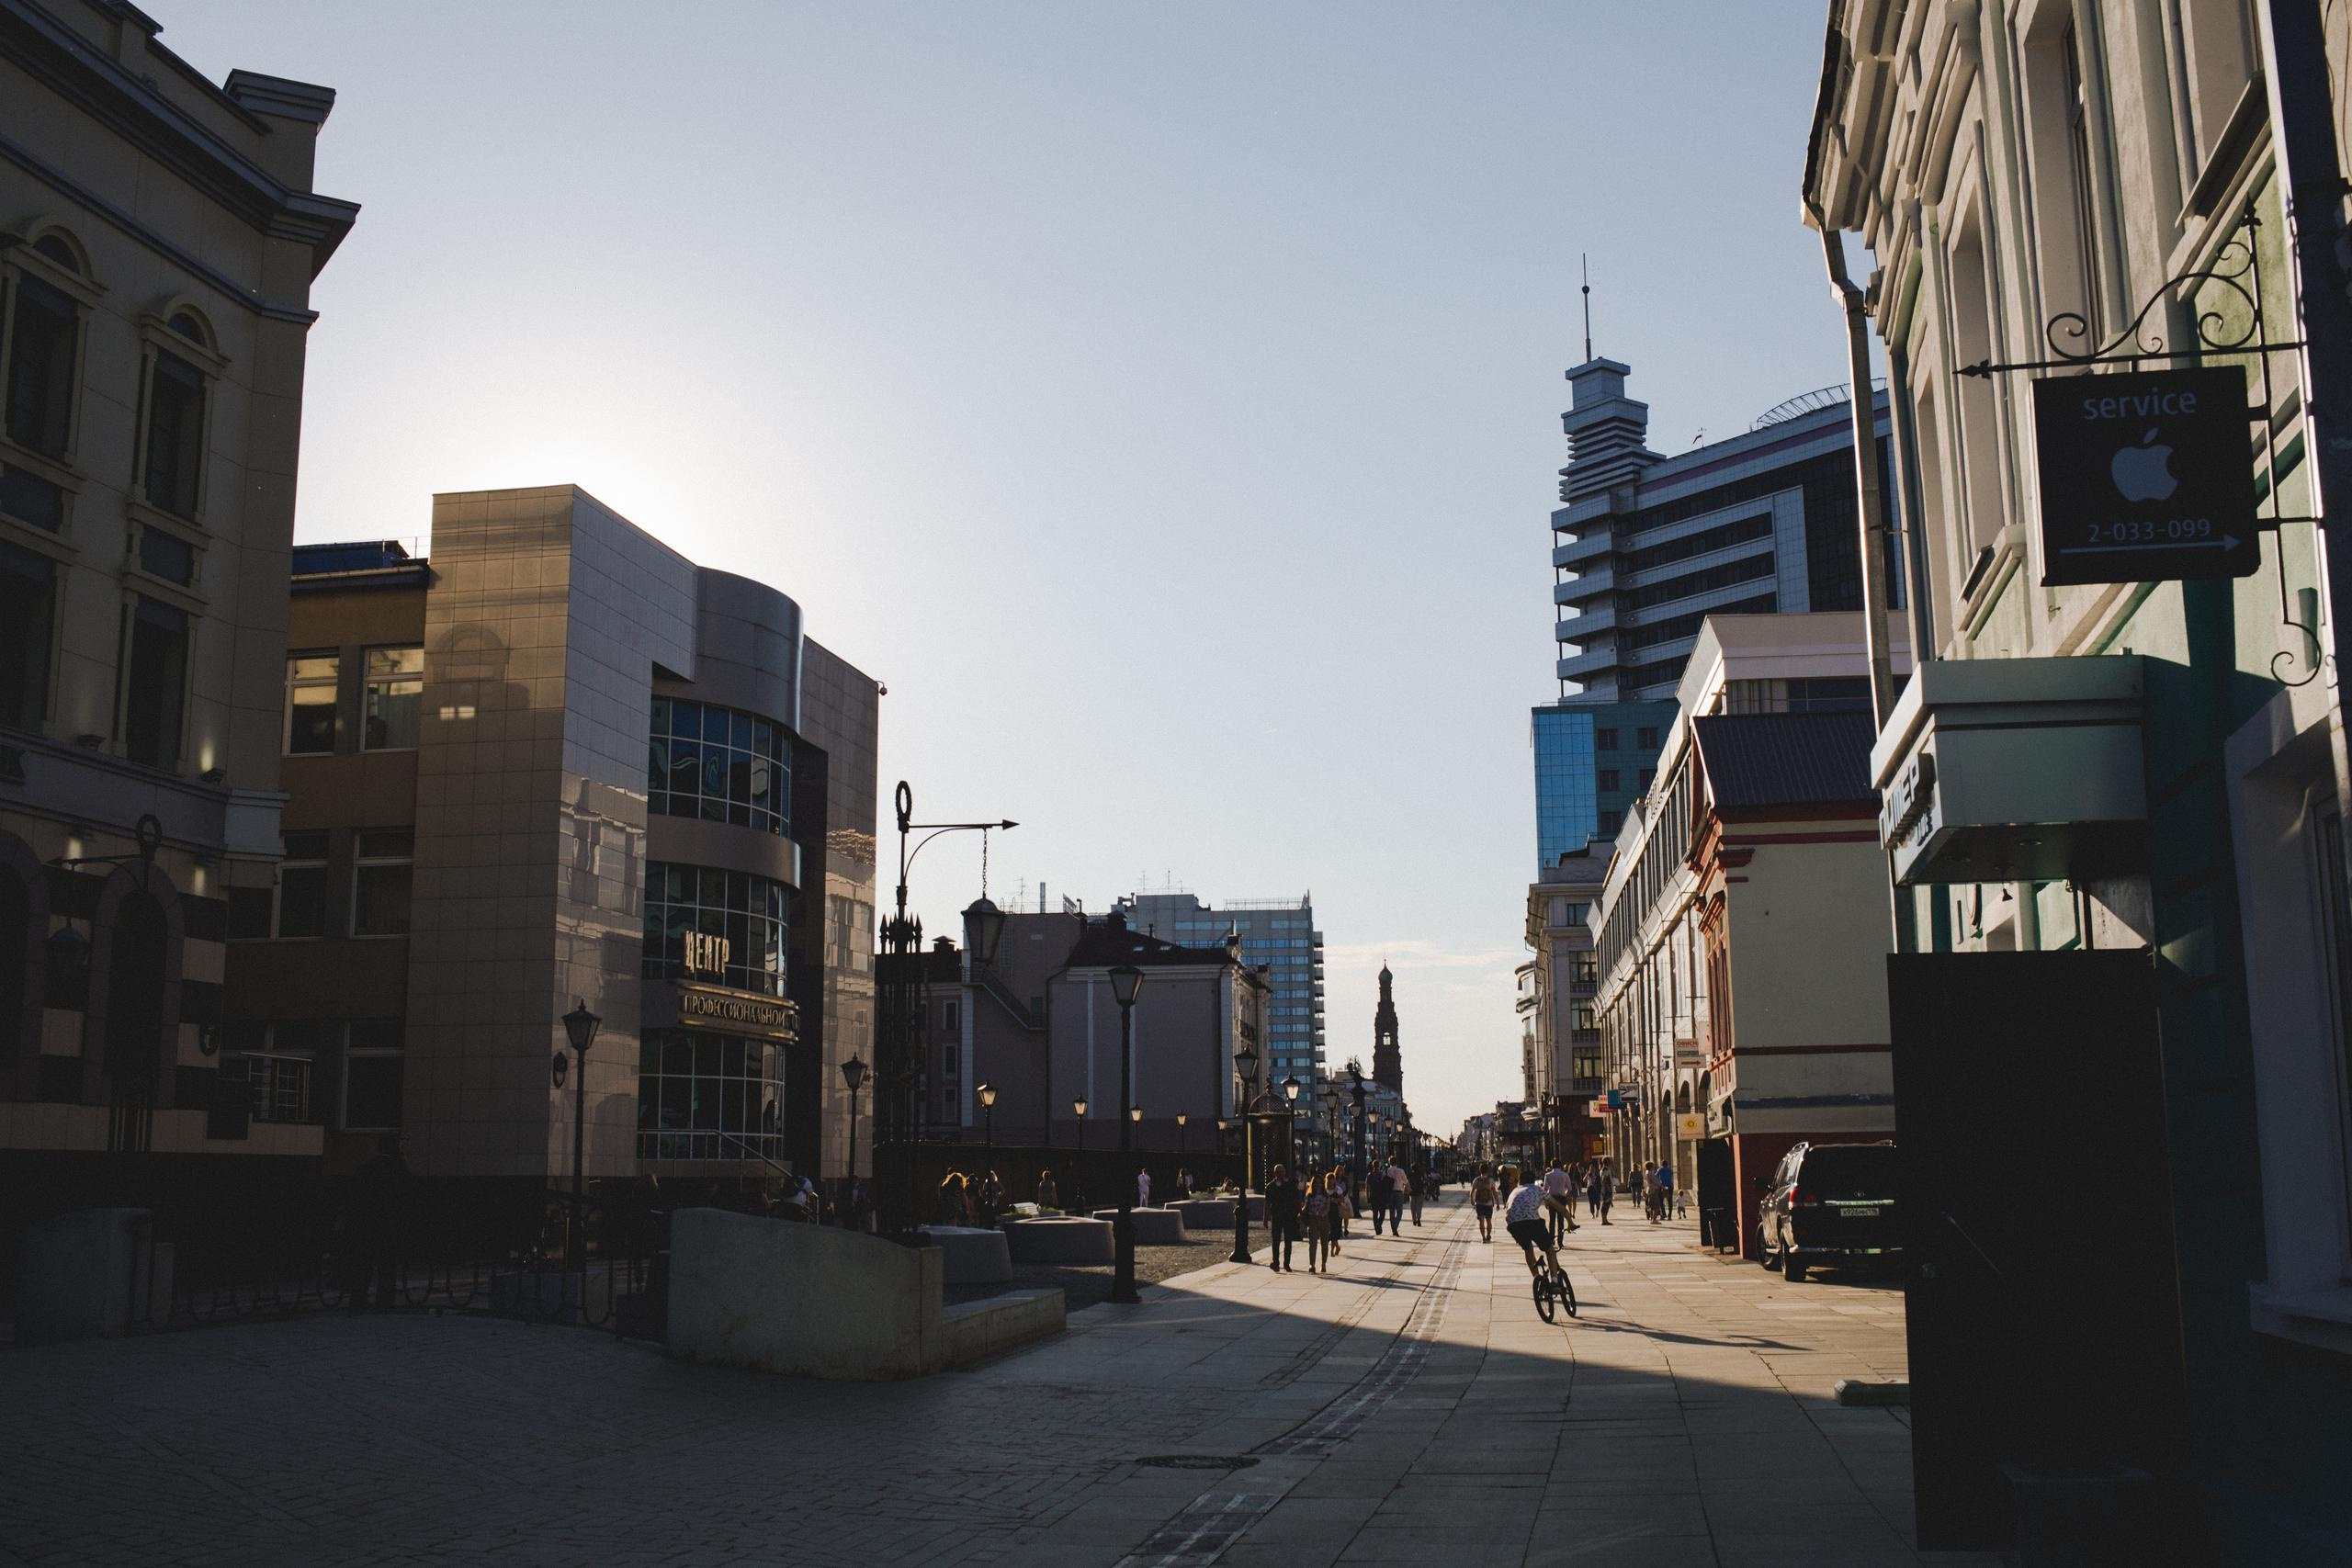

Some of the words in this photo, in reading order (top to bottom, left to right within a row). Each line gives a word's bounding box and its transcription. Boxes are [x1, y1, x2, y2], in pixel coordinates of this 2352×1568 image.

[2083, 387, 2198, 420] service
[2088, 518, 2211, 543] 2-033-099
[683, 931, 730, 974] ЦЕНТР
